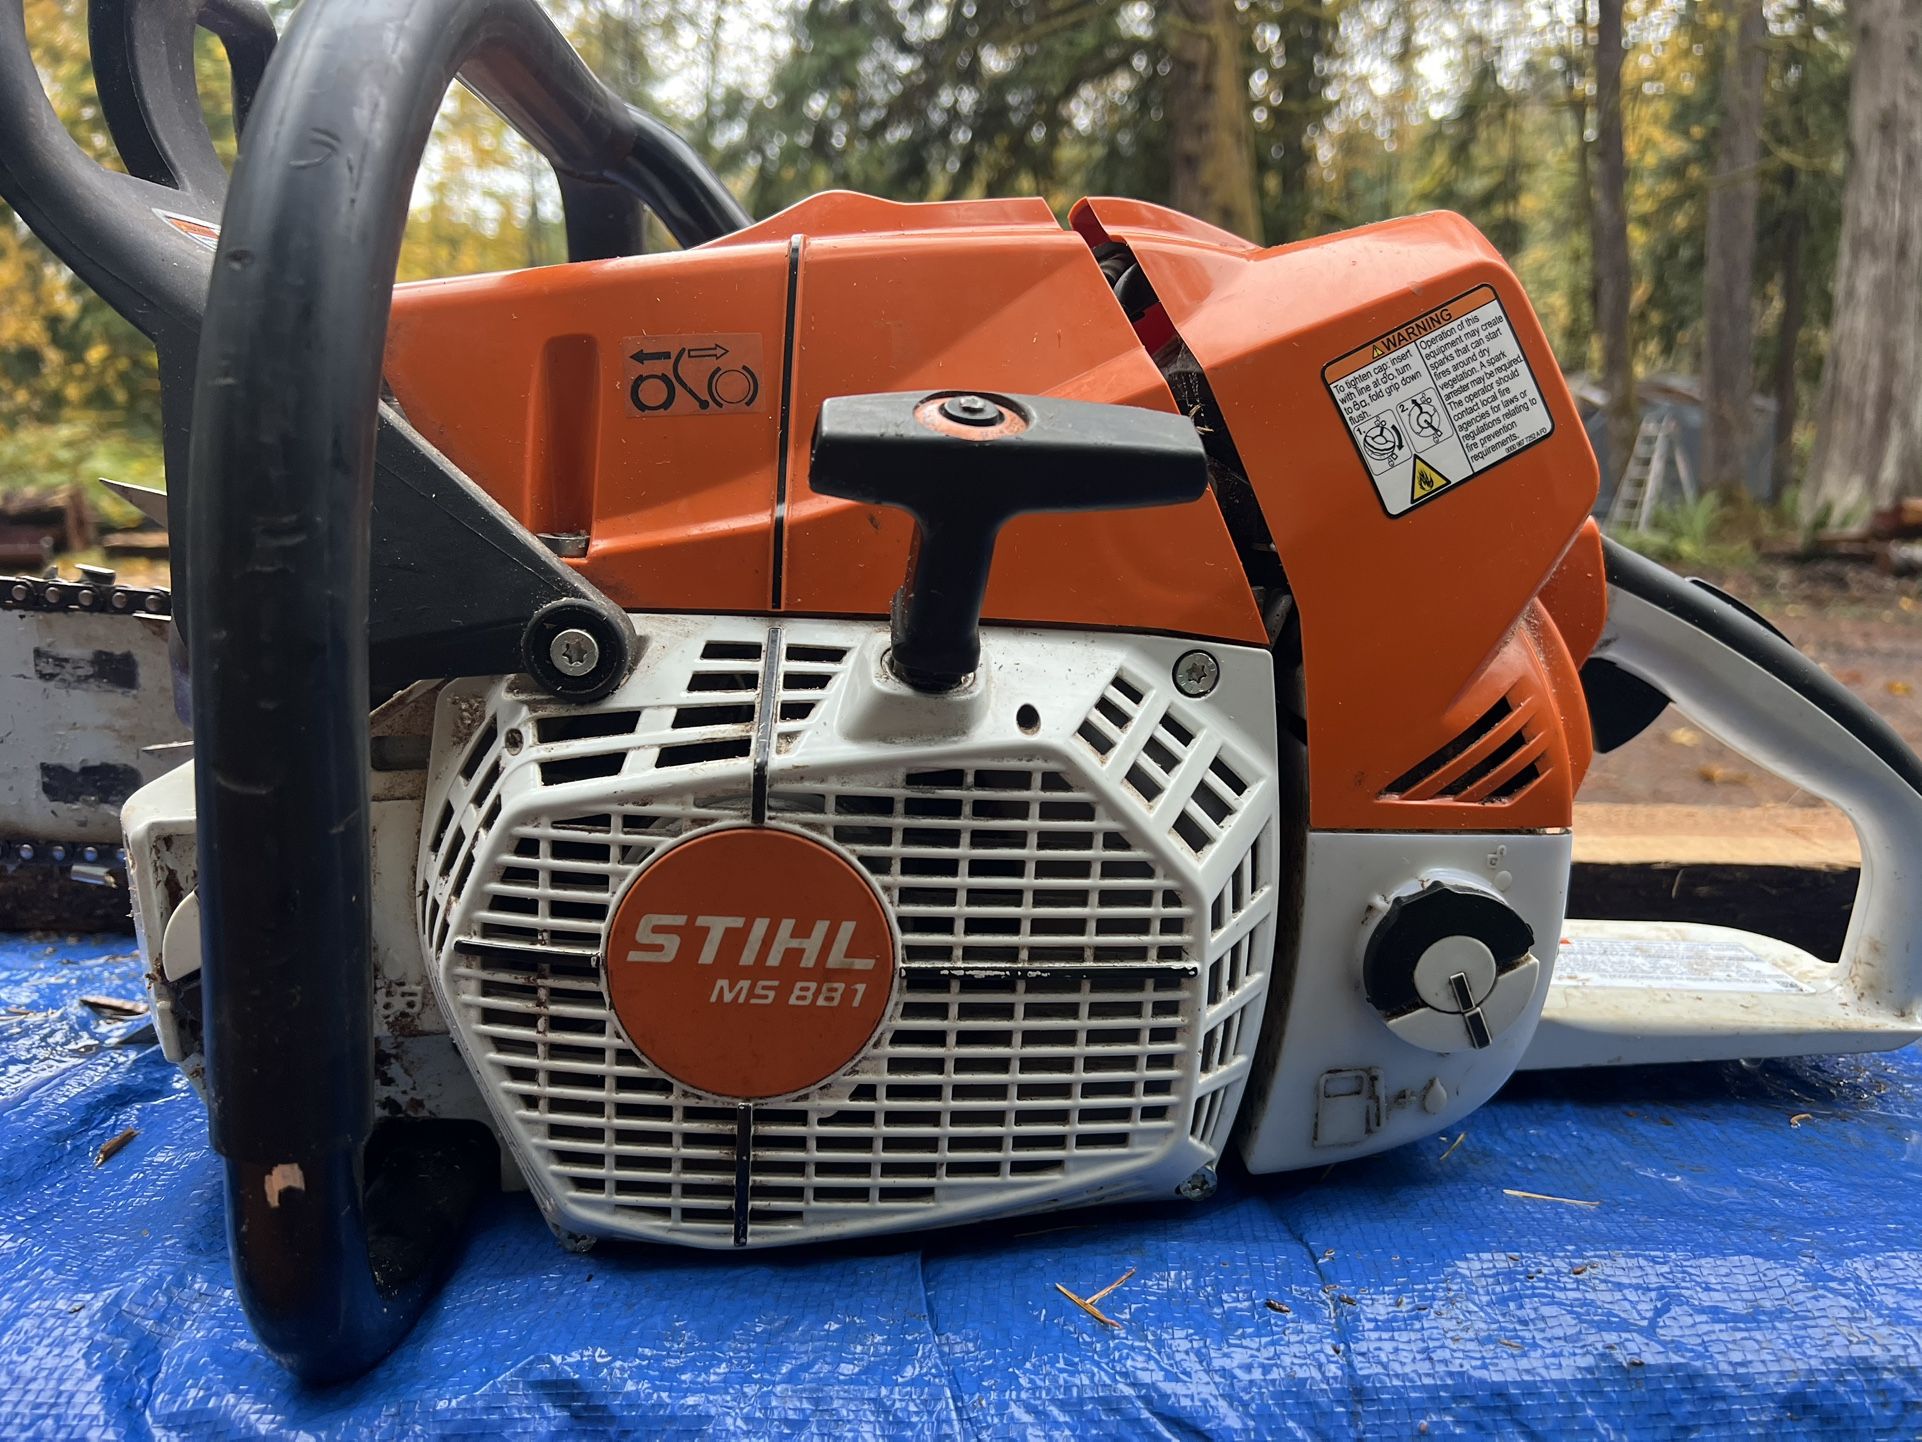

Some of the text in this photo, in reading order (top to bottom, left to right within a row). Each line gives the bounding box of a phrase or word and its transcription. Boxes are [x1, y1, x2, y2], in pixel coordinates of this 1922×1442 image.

[1381, 308, 1452, 349] WARNING
[1418, 314, 1480, 350] Operation of this
[1424, 314, 1503, 360] equipment may create
[1428, 327, 1502, 371] sparks that can start
[1432, 346, 1490, 381] fires around dry
[1332, 348, 1412, 394] To tighten cap: insert
[1338, 362, 1412, 405] with line at turn
[1438, 350, 1507, 390] vegetation. A spark
[1443, 382, 1470, 401] arrester
[1469, 374, 1485, 388] may
[1483, 369, 1495, 380] be
[1446, 367, 1520, 411] The operator should
[1343, 370, 1422, 415] to fold grip down
[1398, 403, 1409, 413] 2.
[1452, 386, 1511, 422] contact local fire
[1457, 389, 1527, 432] agencies for laws or
[1348, 410, 1371, 425] flush.
[1355, 426, 1366, 435] 1.
[1461, 397, 1537, 445] regulations relating to
[1465, 420, 1517, 452] fire prevention
[1469, 432, 1519, 463] requirements.
[626, 913, 876, 970] STIHL
[709, 979, 867, 1008] MS 881
